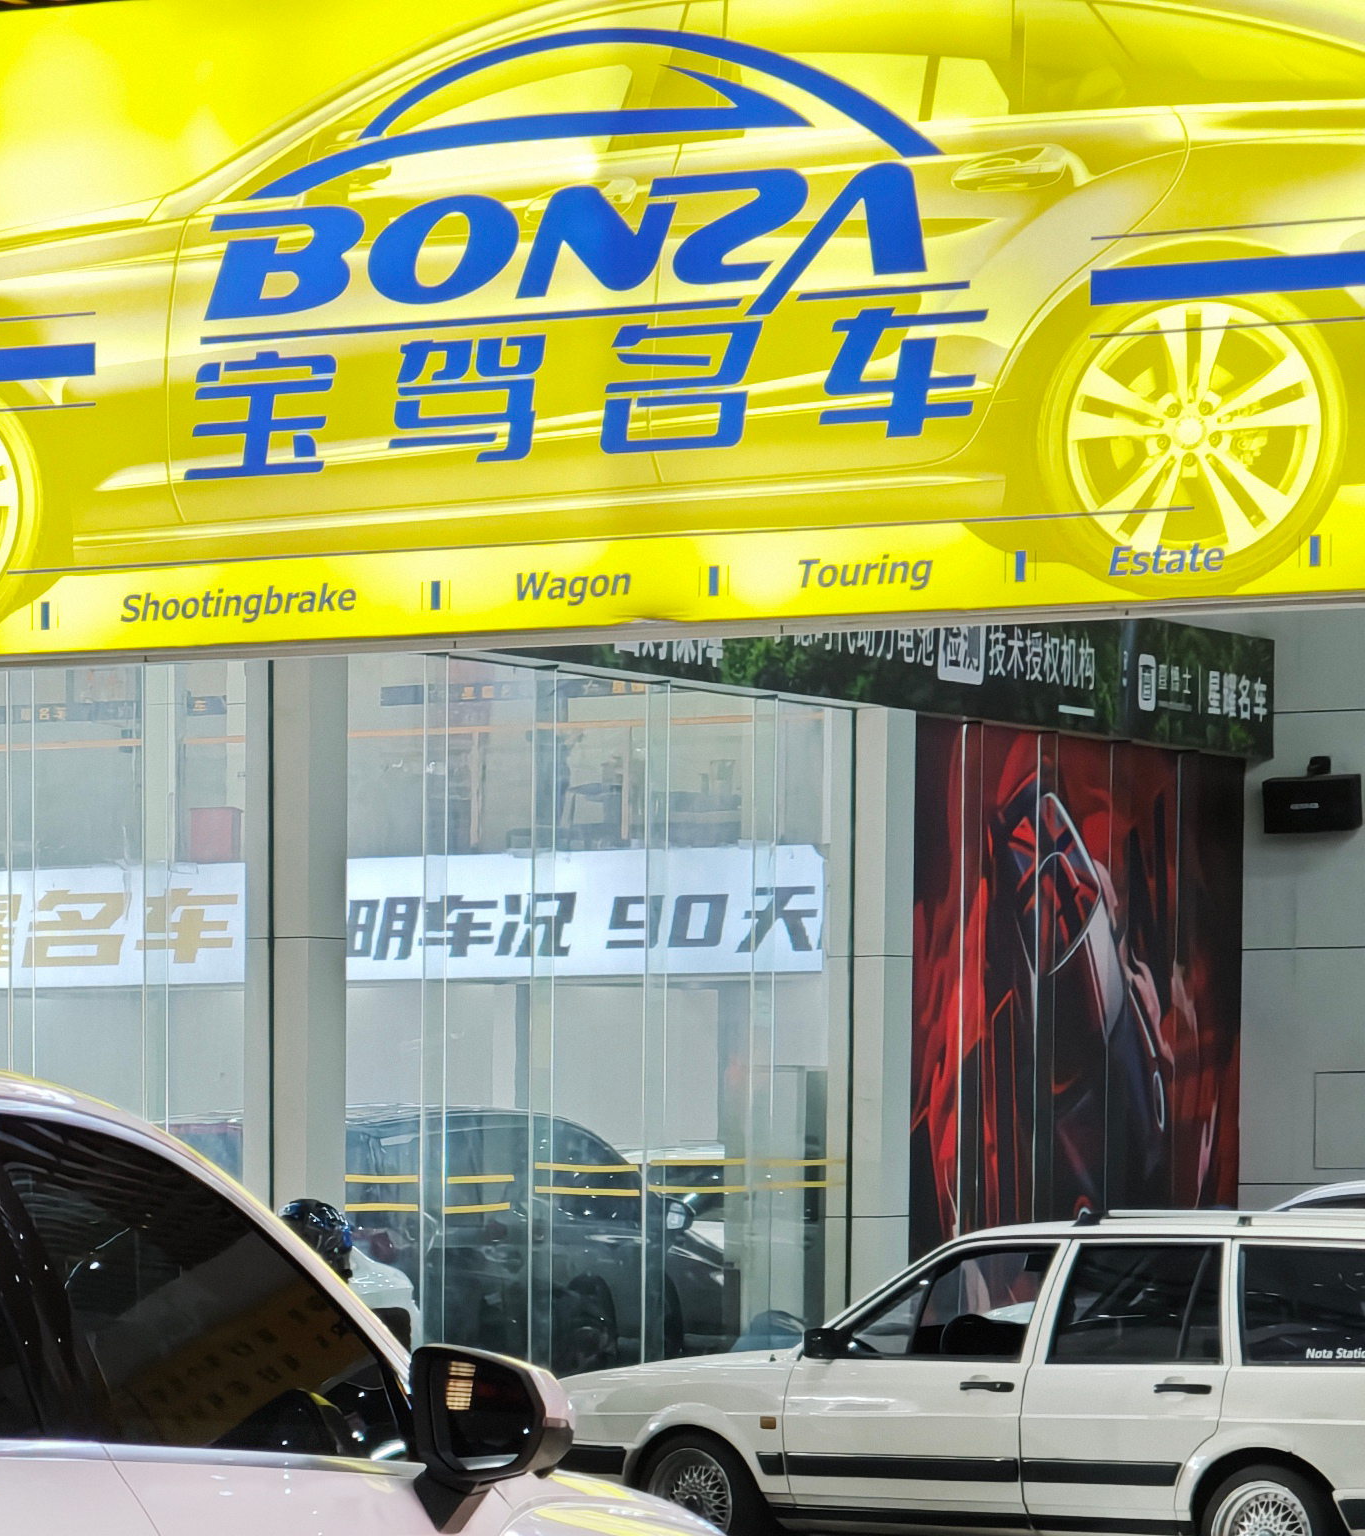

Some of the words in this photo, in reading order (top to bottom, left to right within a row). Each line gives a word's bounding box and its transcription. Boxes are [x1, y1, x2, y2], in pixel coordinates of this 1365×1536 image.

[205, 162, 927, 320] BONZA
[183, 306, 987, 481] 宝驾名车
[121, 585, 357, 627] Shootingbrake
[516, 567, 631, 607] Wagon
[798, 554, 933, 591] Touring
[1108, 544, 1225, 577] Estate
